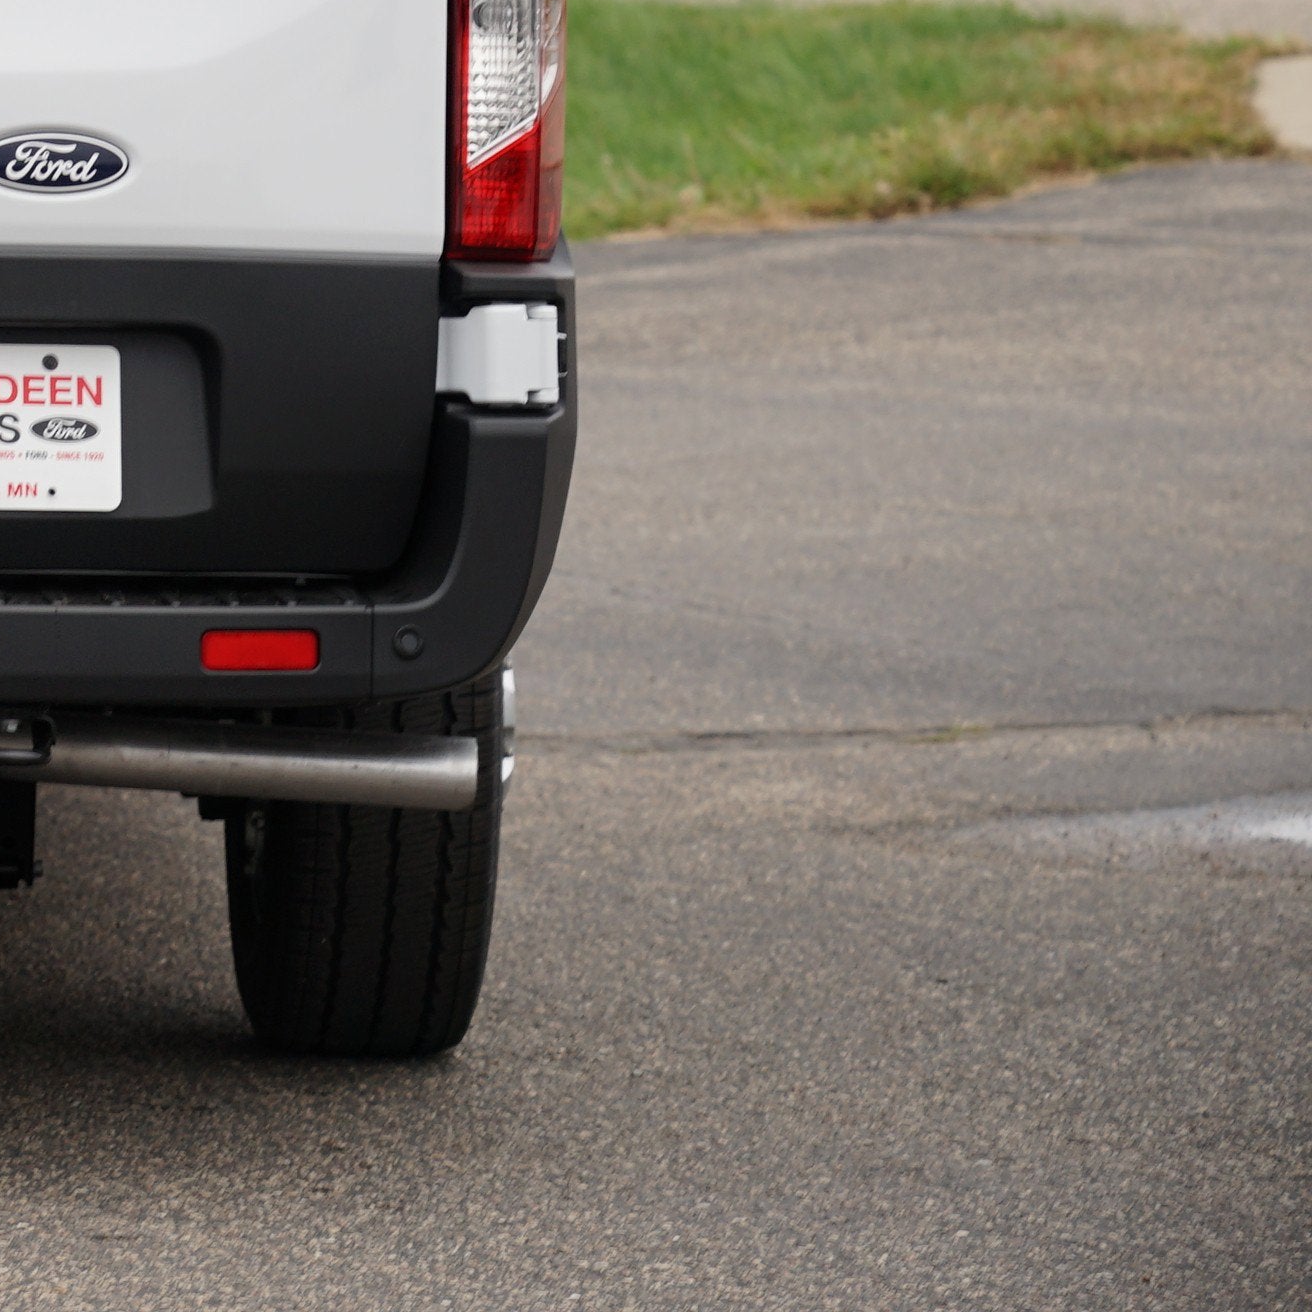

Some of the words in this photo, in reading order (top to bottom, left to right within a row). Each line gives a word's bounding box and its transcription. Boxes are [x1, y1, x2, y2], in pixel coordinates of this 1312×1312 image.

[5, 140, 99, 182] Ford
[41, 417, 89, 441] Ford
[7, 482, 38, 497] MN
